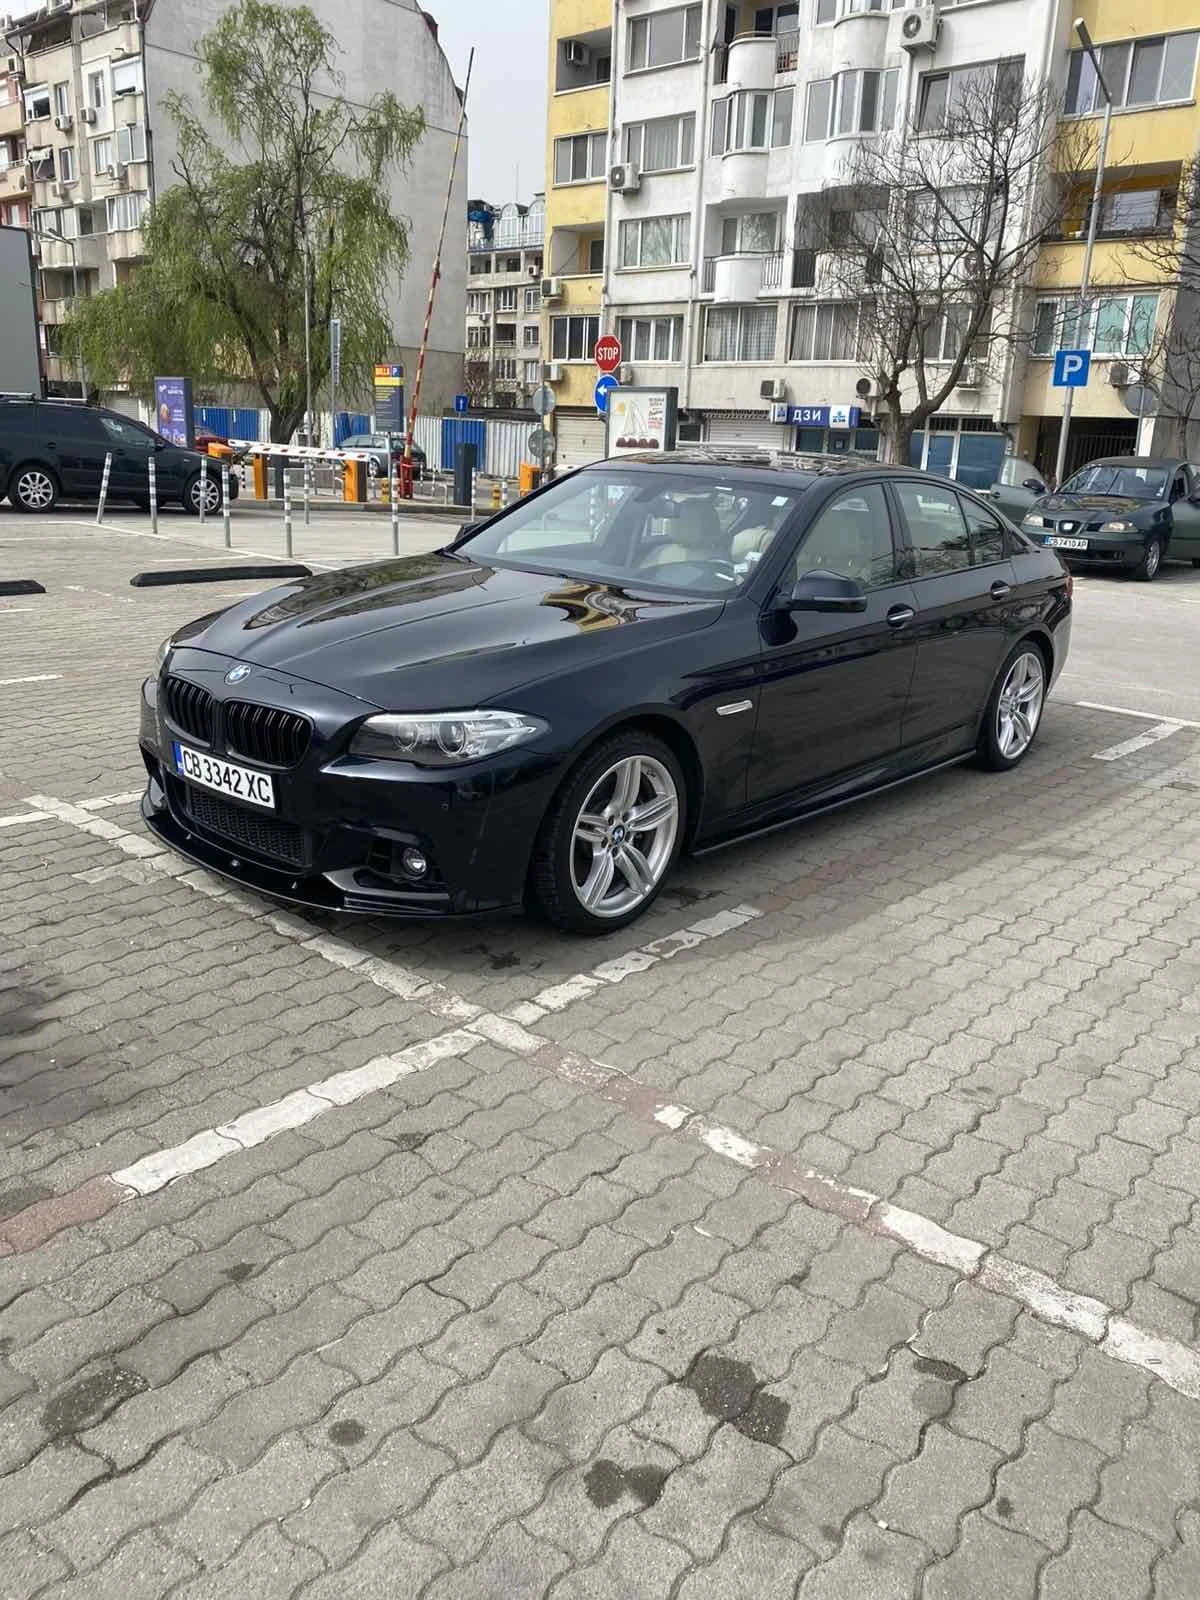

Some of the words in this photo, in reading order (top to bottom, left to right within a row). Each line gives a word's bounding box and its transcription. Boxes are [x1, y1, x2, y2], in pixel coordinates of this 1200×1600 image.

[597, 346, 619, 361] STOP
[1062, 355, 1083, 382] P
[792, 409, 822, 423] ДЗИ
[183, 750, 202, 779] CB
[203, 758, 243, 796] 3342
[245, 772, 270, 803] XC
